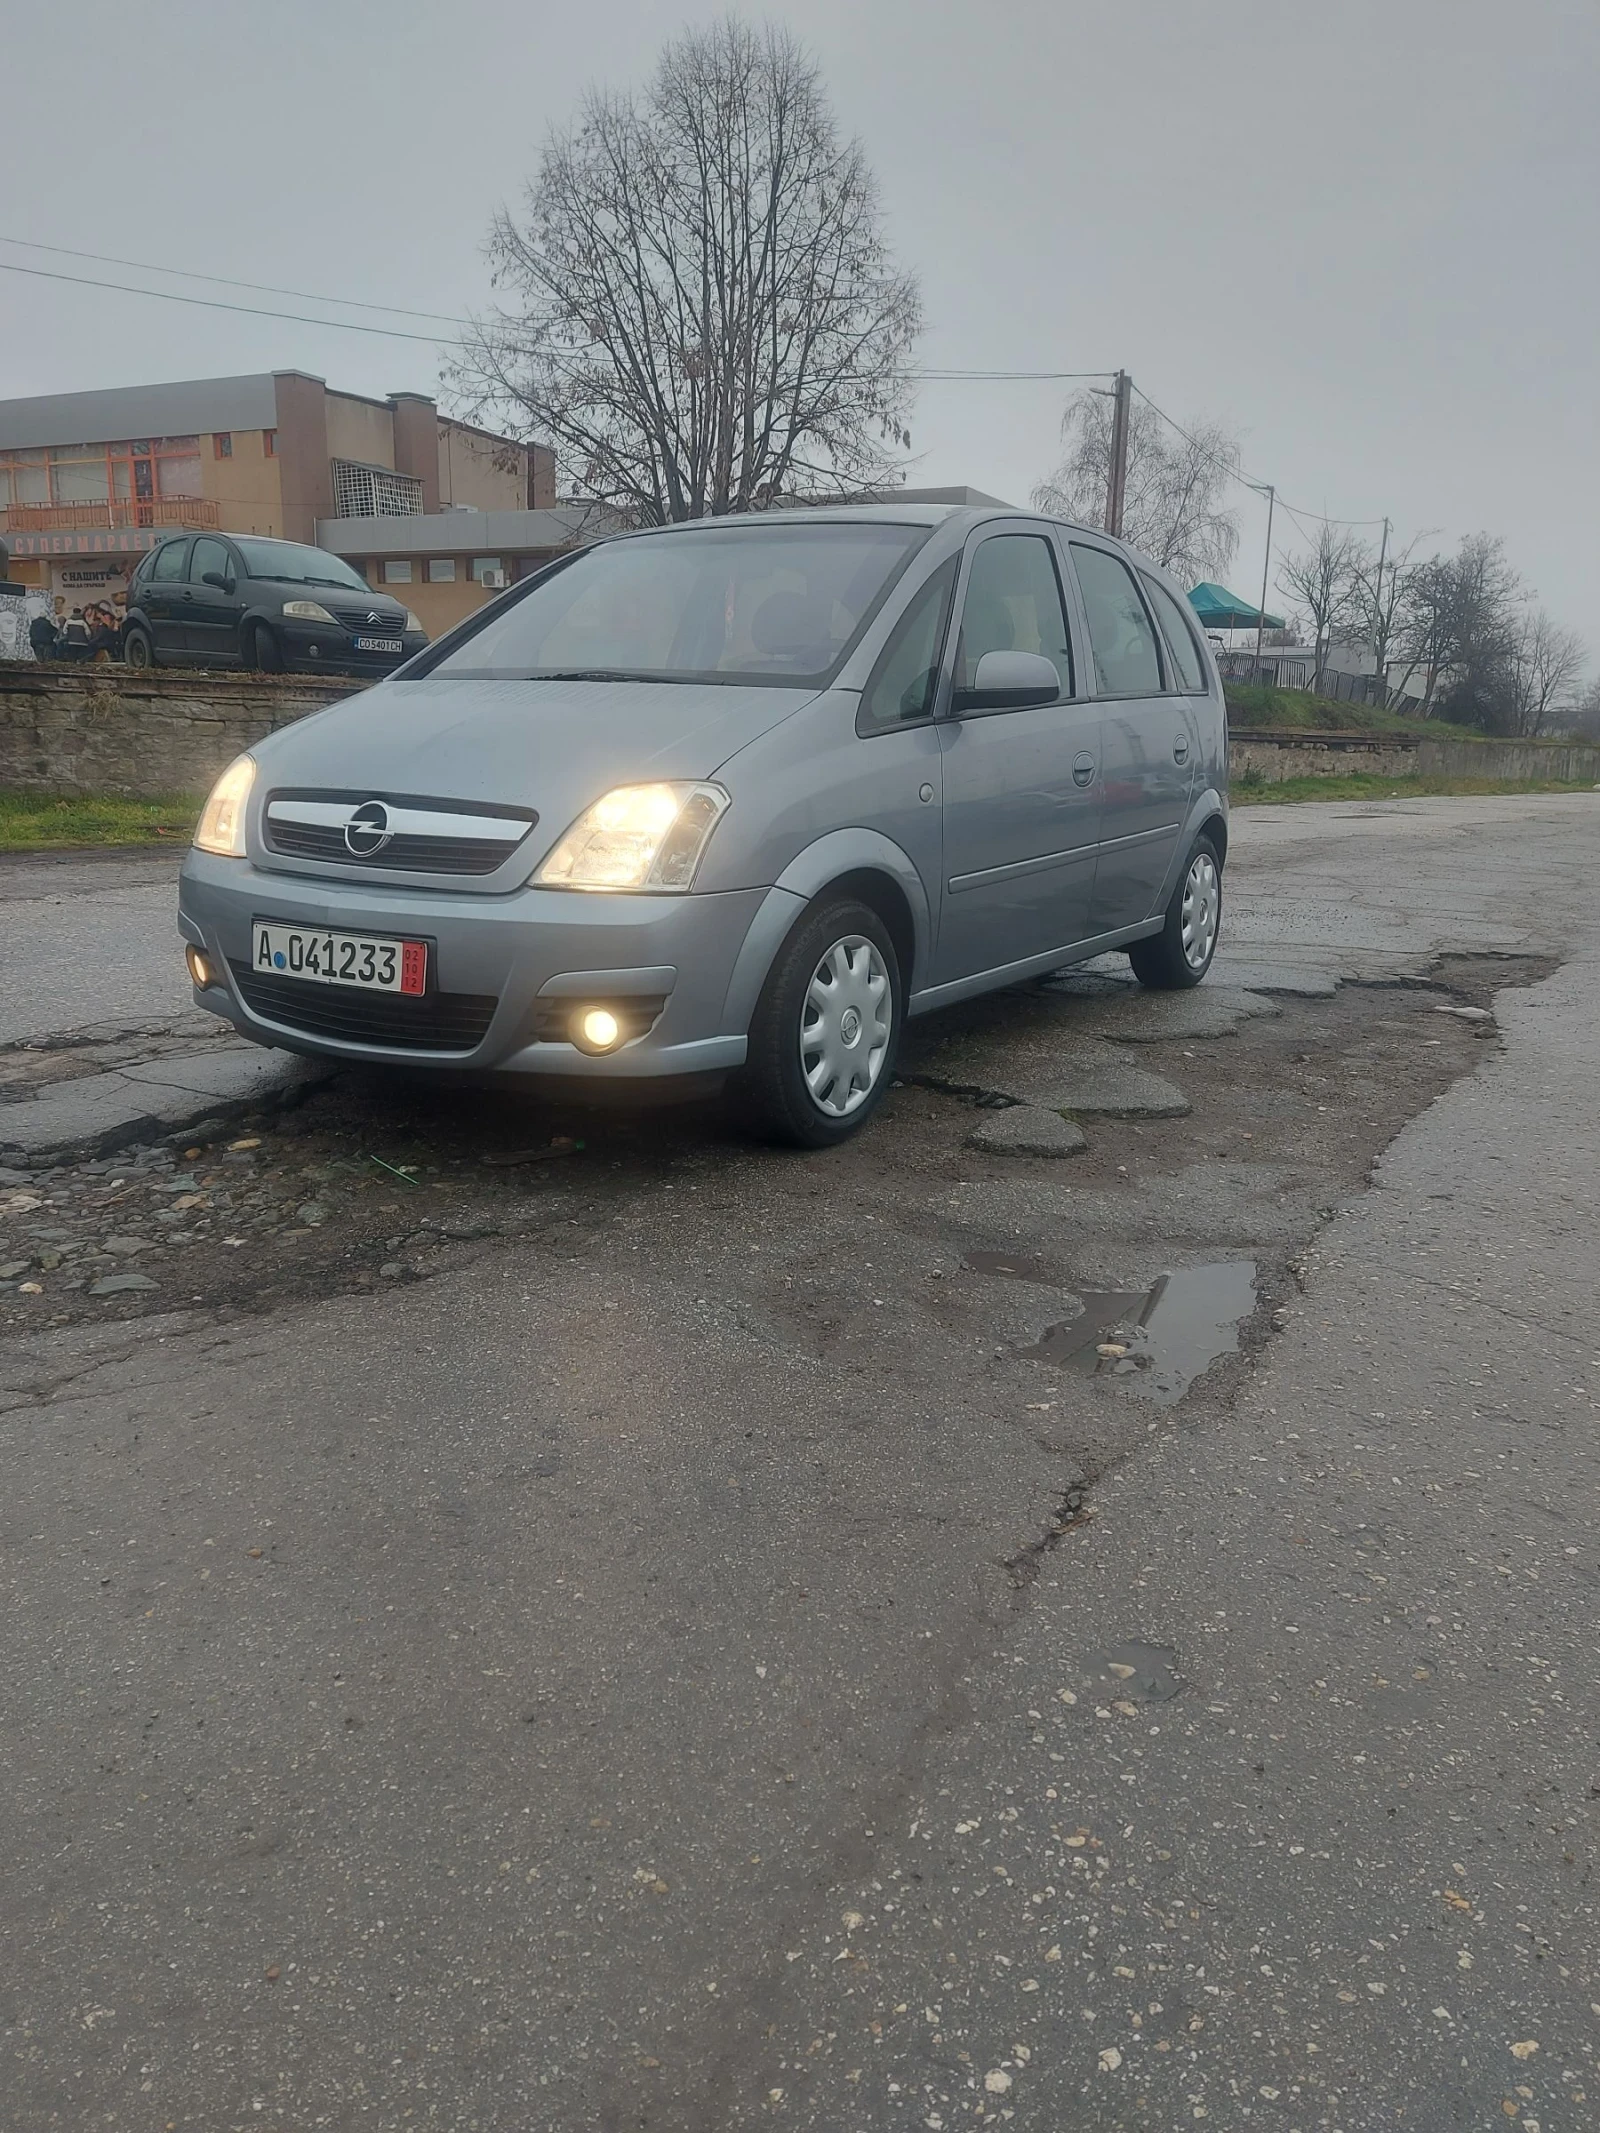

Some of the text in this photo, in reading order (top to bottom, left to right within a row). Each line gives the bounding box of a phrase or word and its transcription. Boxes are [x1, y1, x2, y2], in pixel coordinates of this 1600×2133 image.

[15, 533, 155, 553] СУПЕРМАРКЕТ
[61, 571, 112, 582] С НАШИТЕ
[258, 930, 396, 984] A 041233
[405, 949, 418, 960] 02
[406, 963, 417, 974] 10
[405, 976, 417, 988] 12
